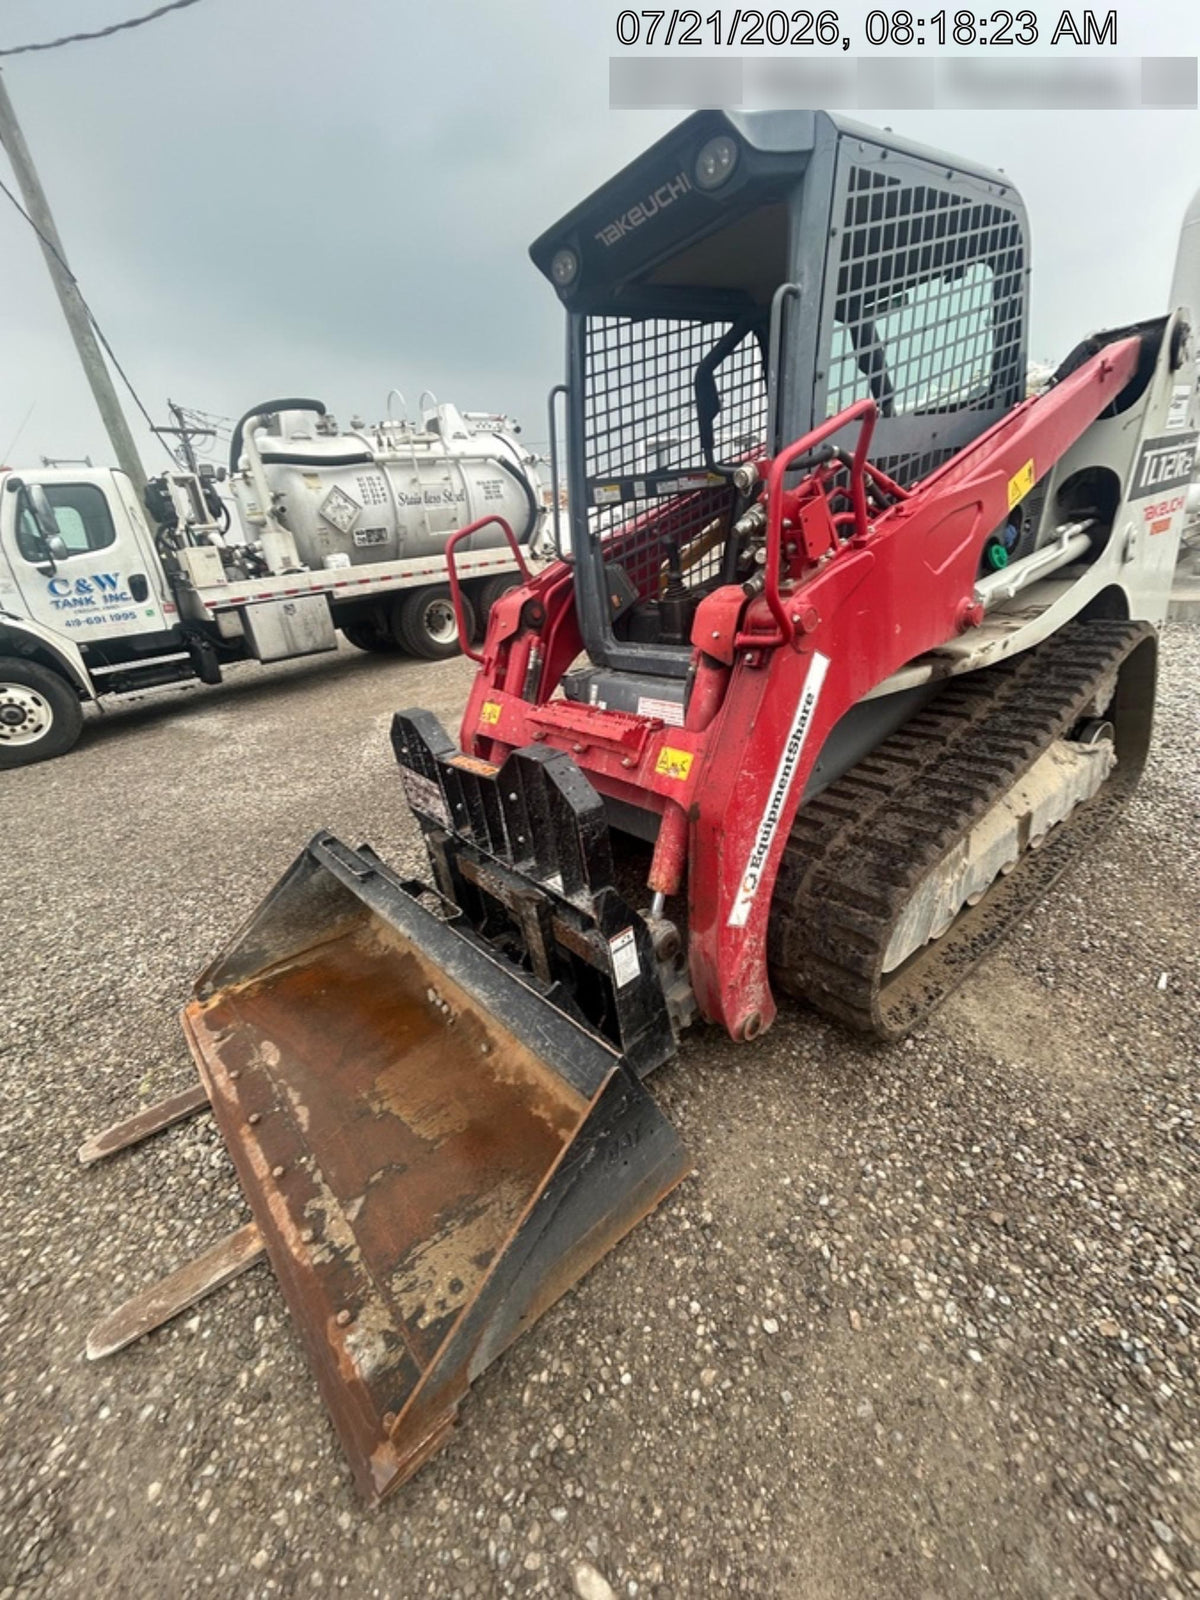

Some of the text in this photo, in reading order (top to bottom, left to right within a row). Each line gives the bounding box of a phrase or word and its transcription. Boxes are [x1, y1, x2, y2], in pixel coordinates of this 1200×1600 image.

[48, 572, 120, 597] C&W
[50, 595, 96, 610] TANK
[102, 591, 132, 604] INC.
[750, 692, 815, 871] EquipmentShare
